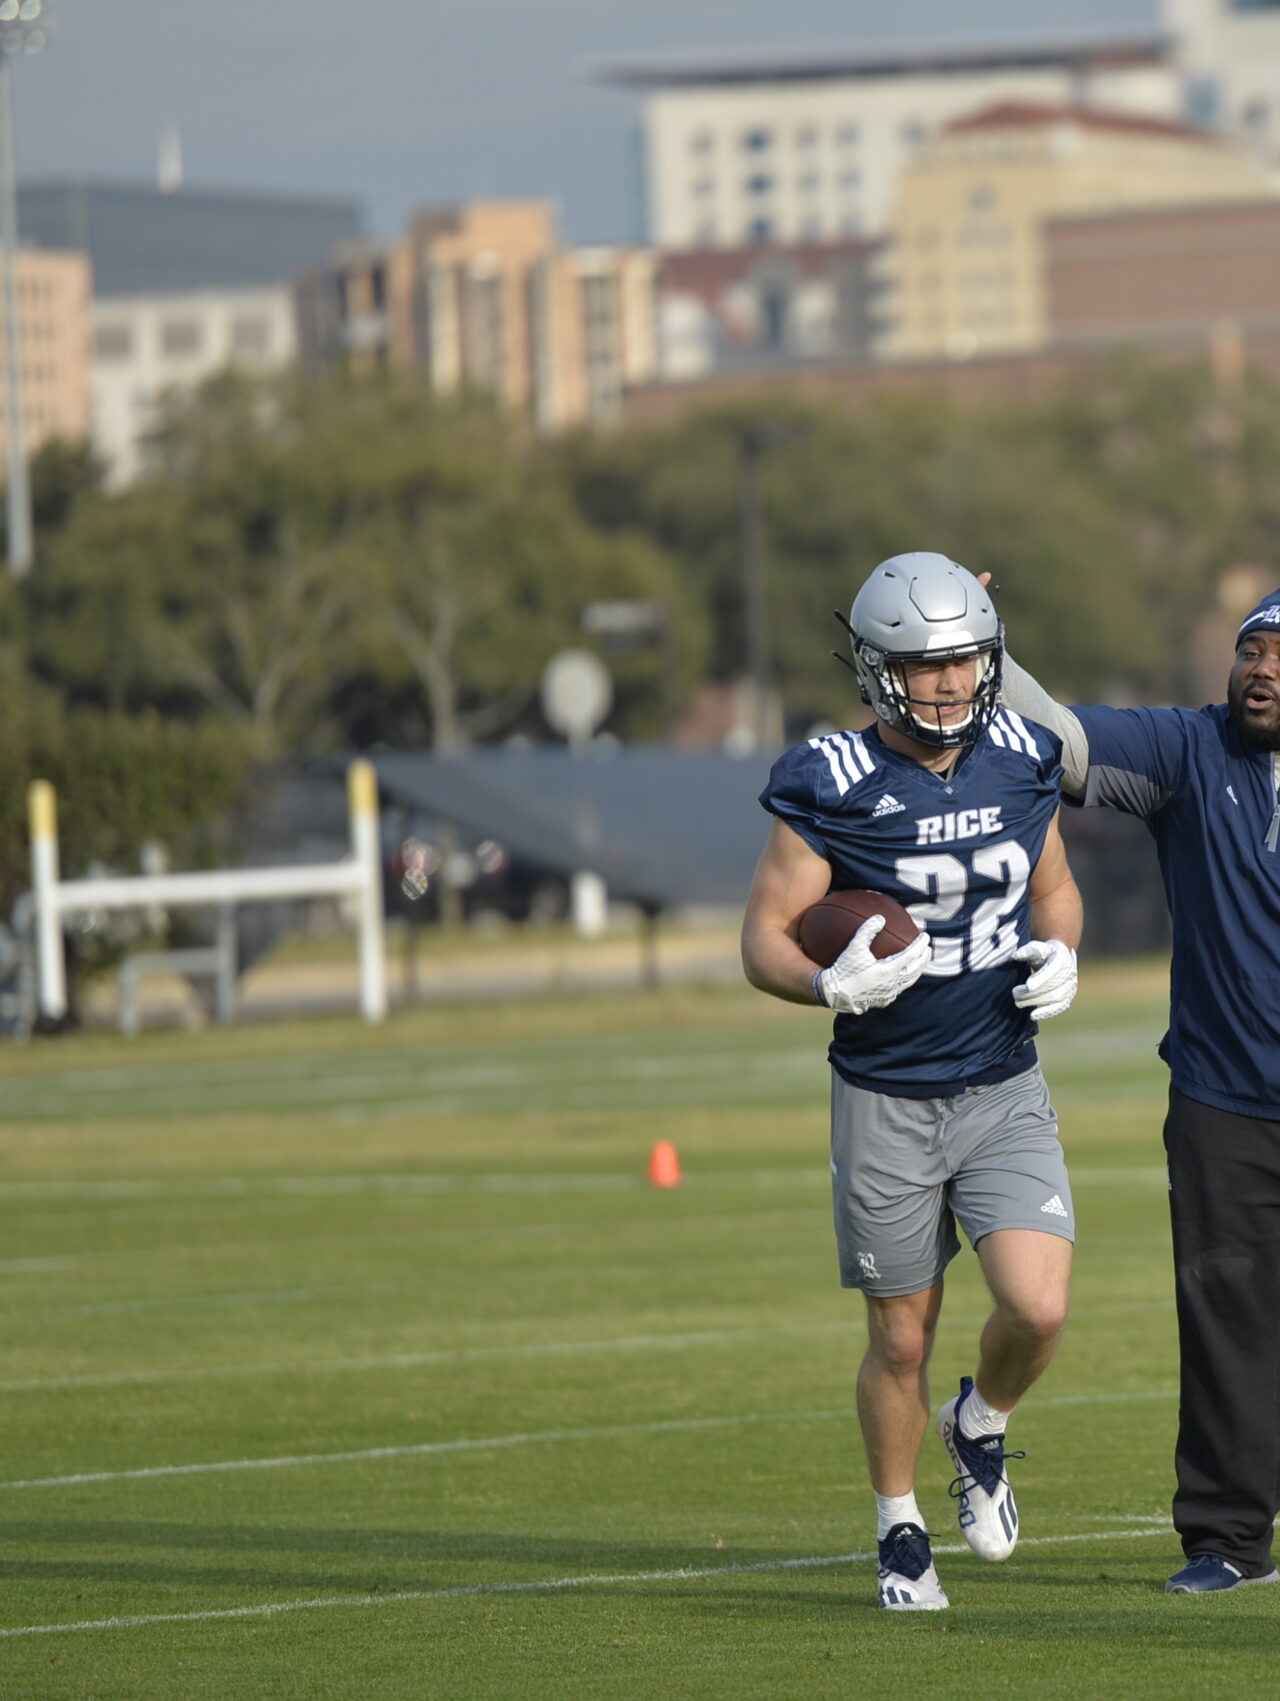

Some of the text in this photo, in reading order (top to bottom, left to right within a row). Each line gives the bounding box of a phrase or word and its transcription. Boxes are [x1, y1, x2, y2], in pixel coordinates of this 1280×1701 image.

[872, 803, 906, 817] adidas
[915, 806, 1004, 845] RICE
[895, 839, 1031, 977] 22
